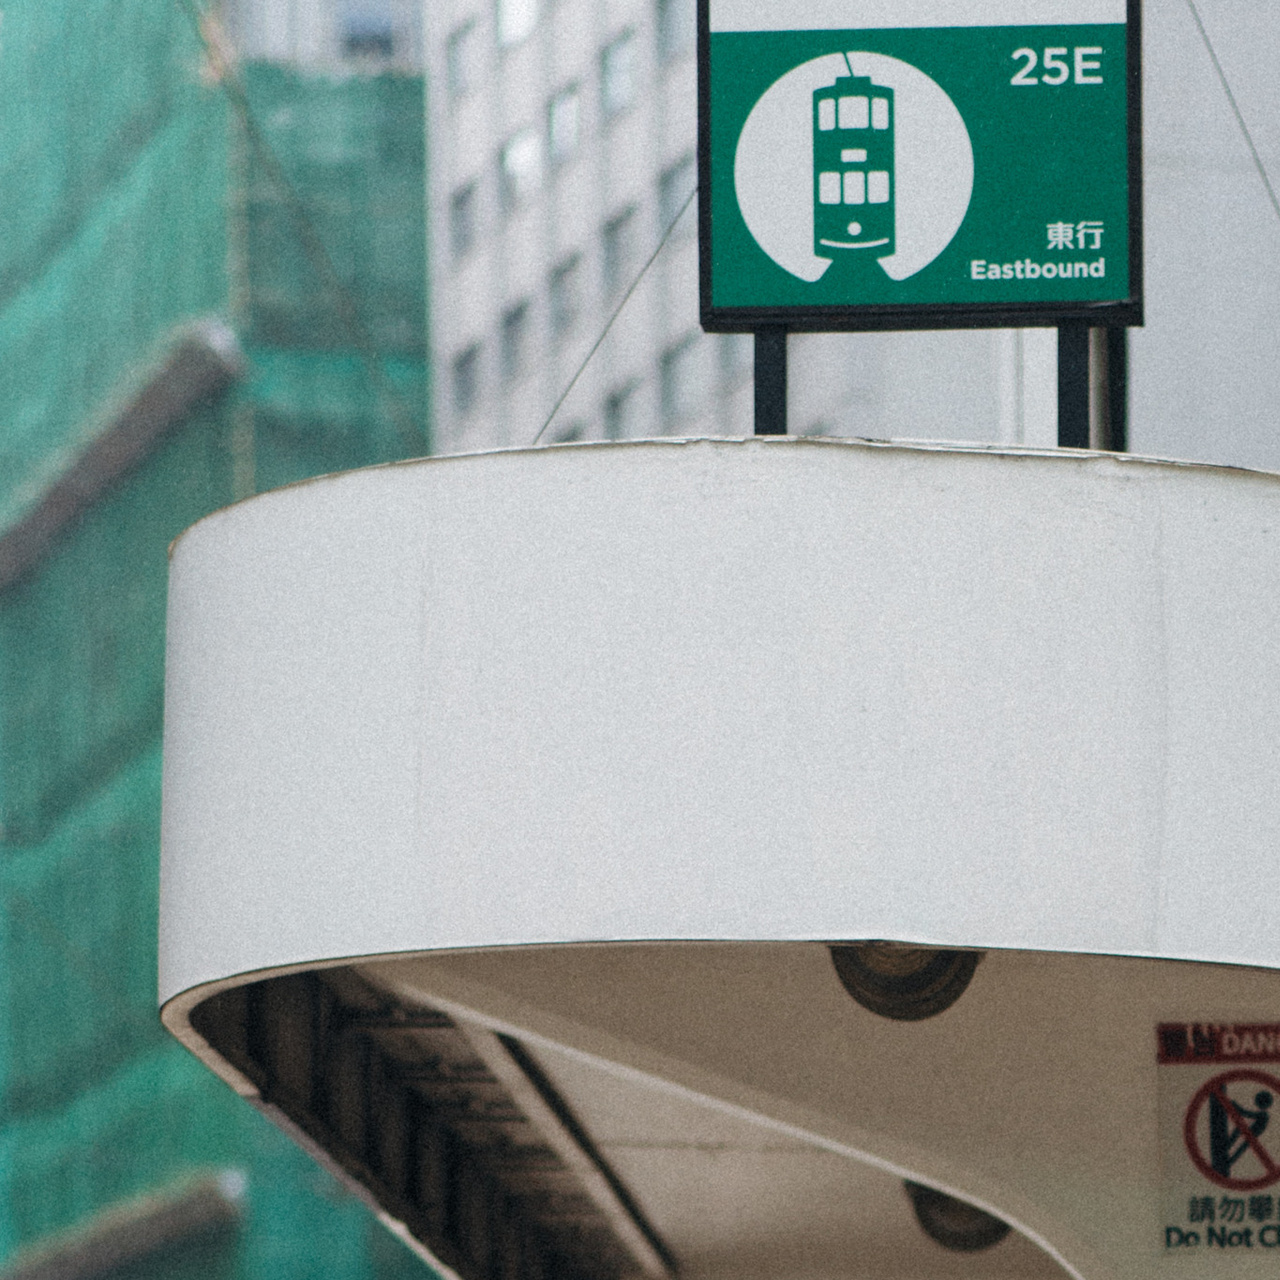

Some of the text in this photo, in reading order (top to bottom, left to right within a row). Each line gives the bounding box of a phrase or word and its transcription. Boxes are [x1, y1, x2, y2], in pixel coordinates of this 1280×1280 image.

[1010, 47, 1104, 86] 25E
[1047, 221, 1105, 250] 東行
[970, 257, 1106, 281] Eastbound
[1165, 1226, 1199, 1248] Do
[1207, 1226, 1253, 1248] Not
